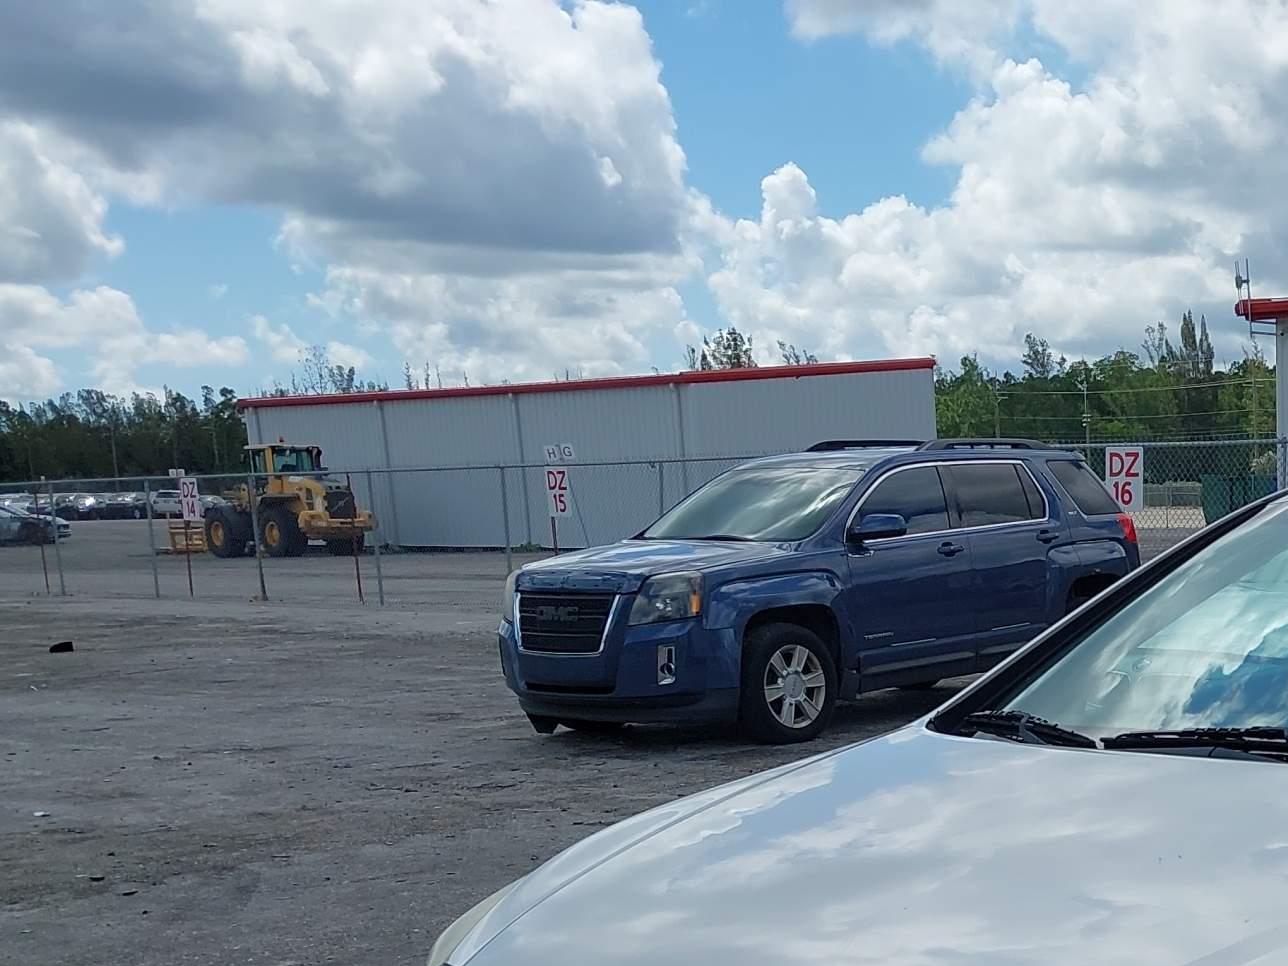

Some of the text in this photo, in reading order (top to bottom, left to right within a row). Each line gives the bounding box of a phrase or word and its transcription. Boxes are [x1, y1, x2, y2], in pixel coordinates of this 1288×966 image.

[547, 446, 572, 459] H G
[1109, 451, 1140, 477] DZ
[182, 481, 197, 498] DZ
[546, 470, 567, 490] DZ
[553, 493, 567, 513] 15
[1112, 481, 1133, 505] 16
[186, 500, 196, 517] 14
